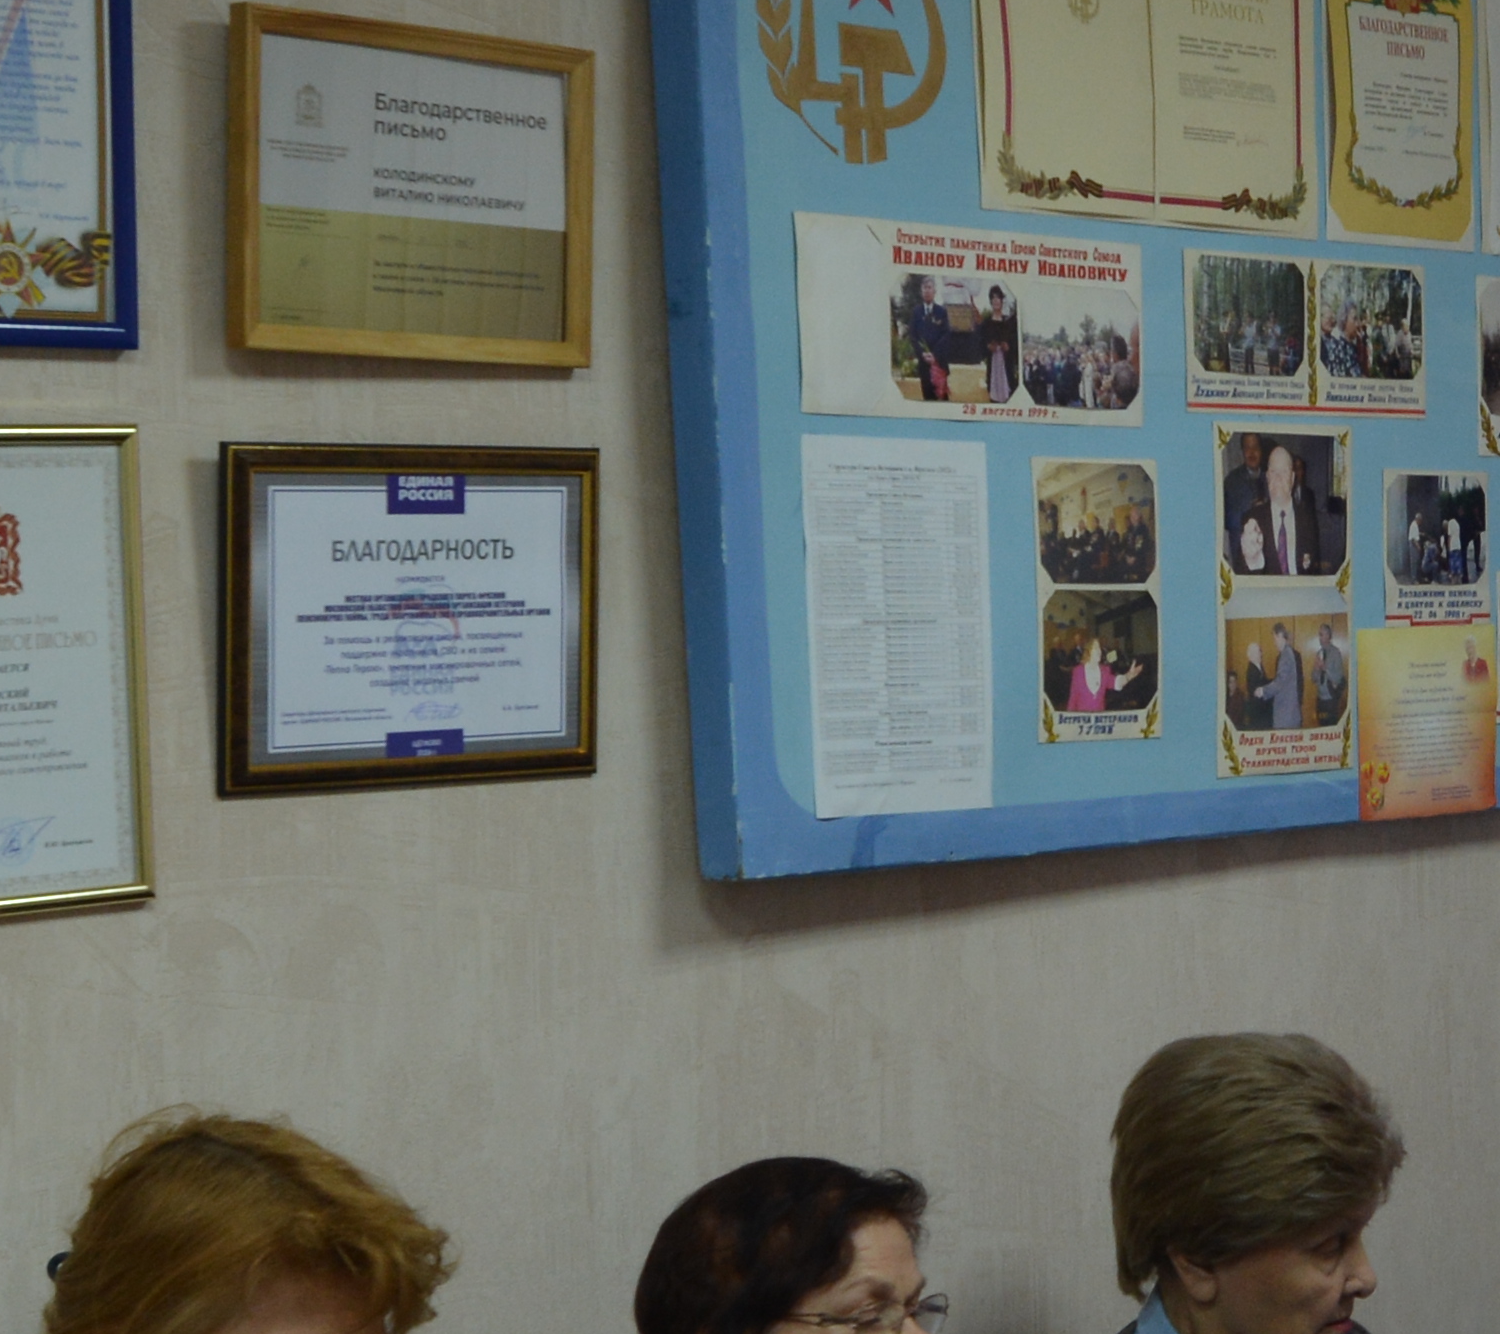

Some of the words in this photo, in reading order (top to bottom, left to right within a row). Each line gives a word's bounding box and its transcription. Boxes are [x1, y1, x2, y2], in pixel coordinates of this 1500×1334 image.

[1358, 15, 1449, 44] БЛАГОДАРСТВЕННОЕ
[1386, 42, 1426, 61] ПИСЬМО
[374, 93, 548, 130] Благодарственное
[374, 120, 446, 141] письмо
[374, 168, 476, 187] КОЛОДИНСКОМУ
[374, 187, 434, 203] ВИТАЛИЮ
[437, 192, 525, 211] НИКОЛАЕВИЧУ
[398, 476, 455, 488] ЕДИНАЯ
[398, 489, 455, 501] РОССИЯ
[332, 539, 514, 564] БЛАГОДАРНОСТЬ
